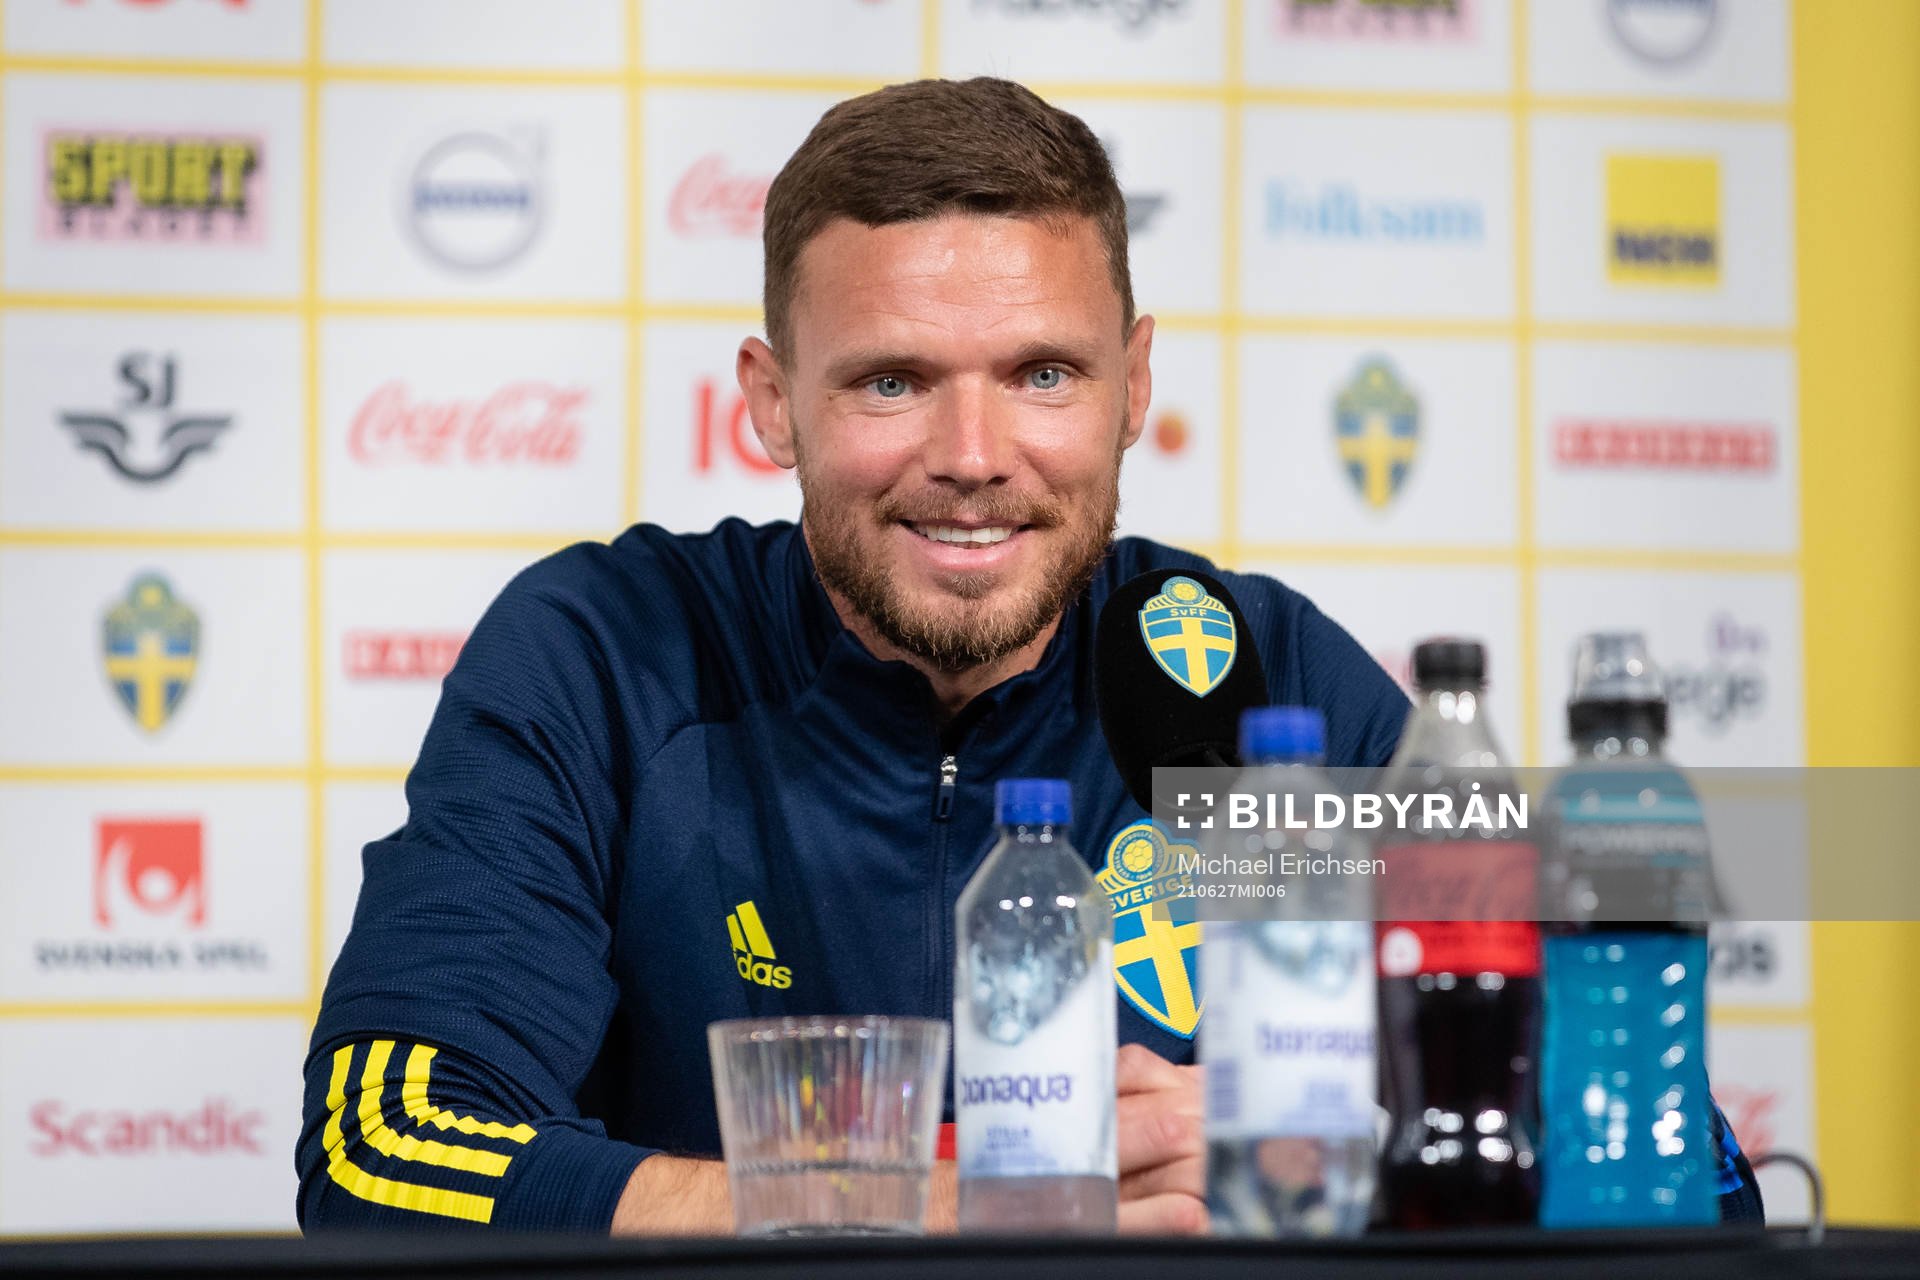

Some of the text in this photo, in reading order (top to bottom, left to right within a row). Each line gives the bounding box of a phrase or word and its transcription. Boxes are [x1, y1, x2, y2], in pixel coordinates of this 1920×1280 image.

[118, 352, 176, 407] SJ
[1169, 607, 1208, 617] SvFF
[732, 953, 793, 990] das
[30, 1100, 265, 1156] Scandic
